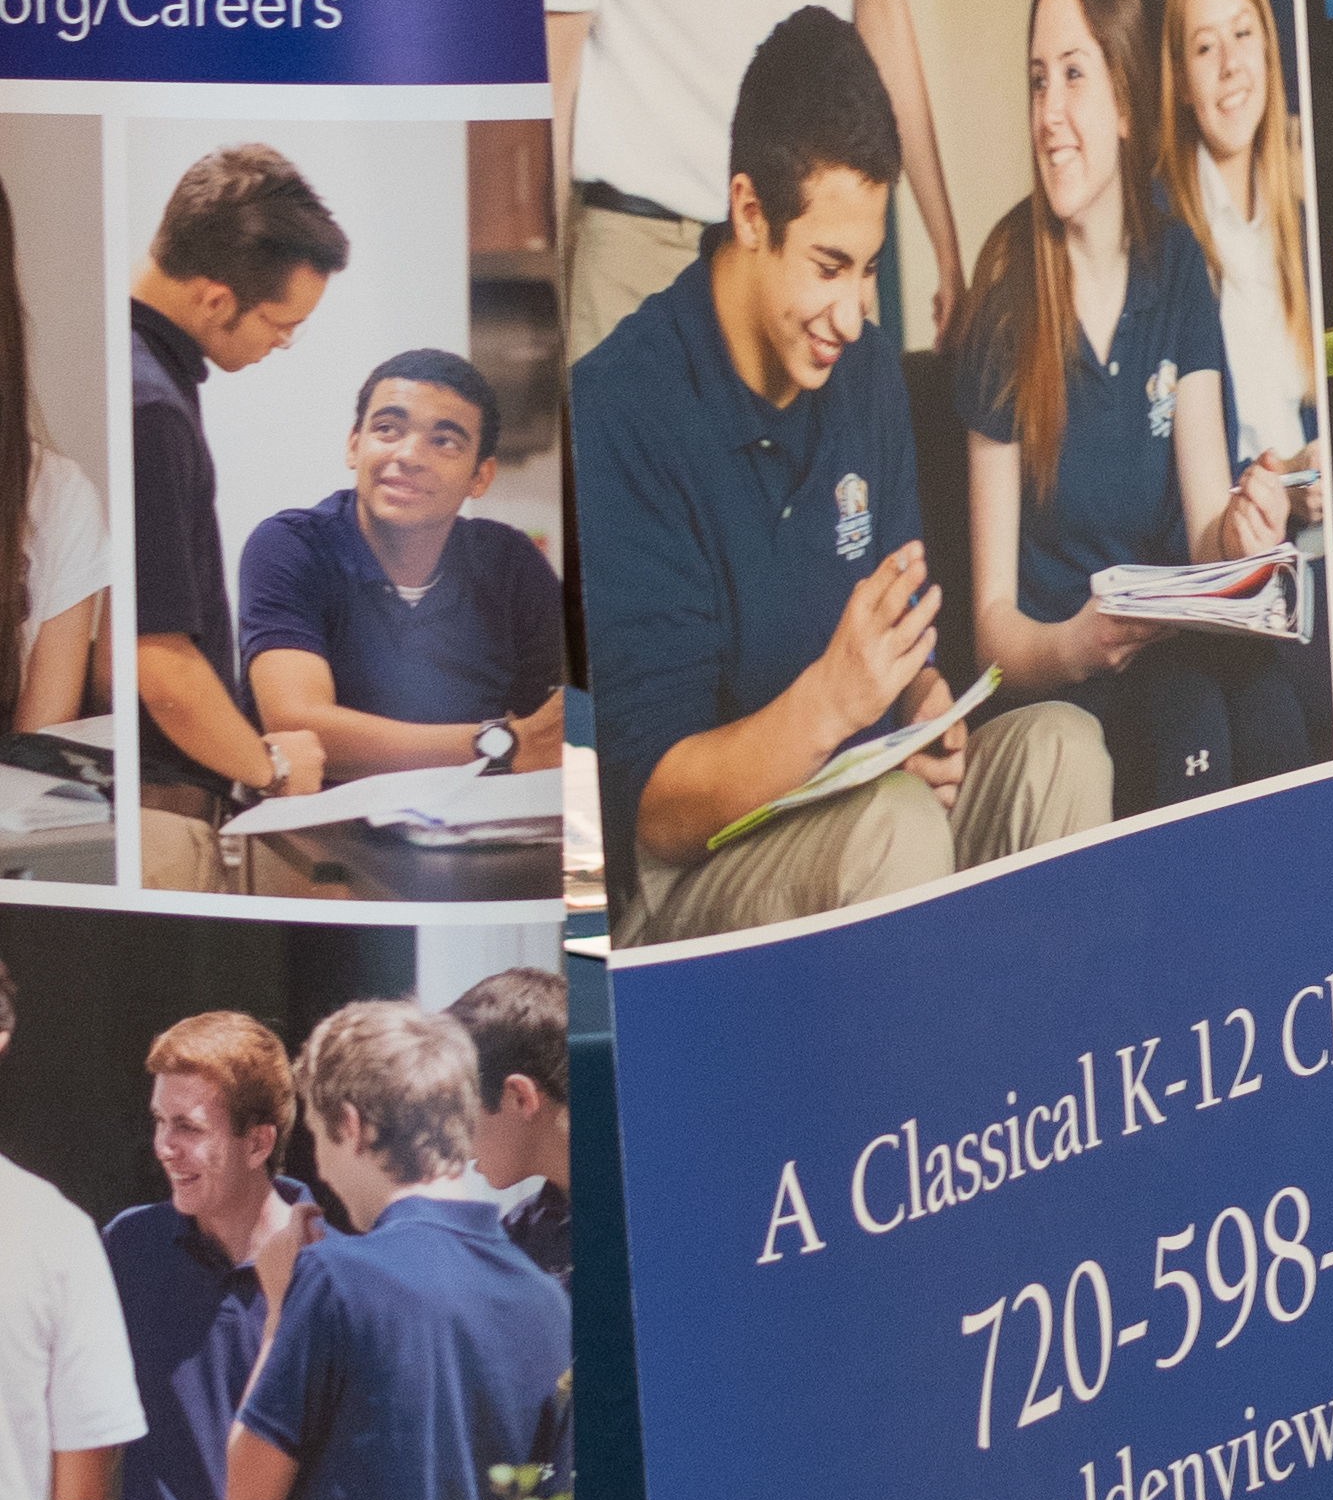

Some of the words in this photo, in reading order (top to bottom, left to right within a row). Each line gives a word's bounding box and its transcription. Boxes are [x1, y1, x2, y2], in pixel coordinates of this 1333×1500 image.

[756, 1159, 827, 1265] A
[850, 1051, 1103, 1235] Classical
[1115, 1006, 1263, 1137] K-12
